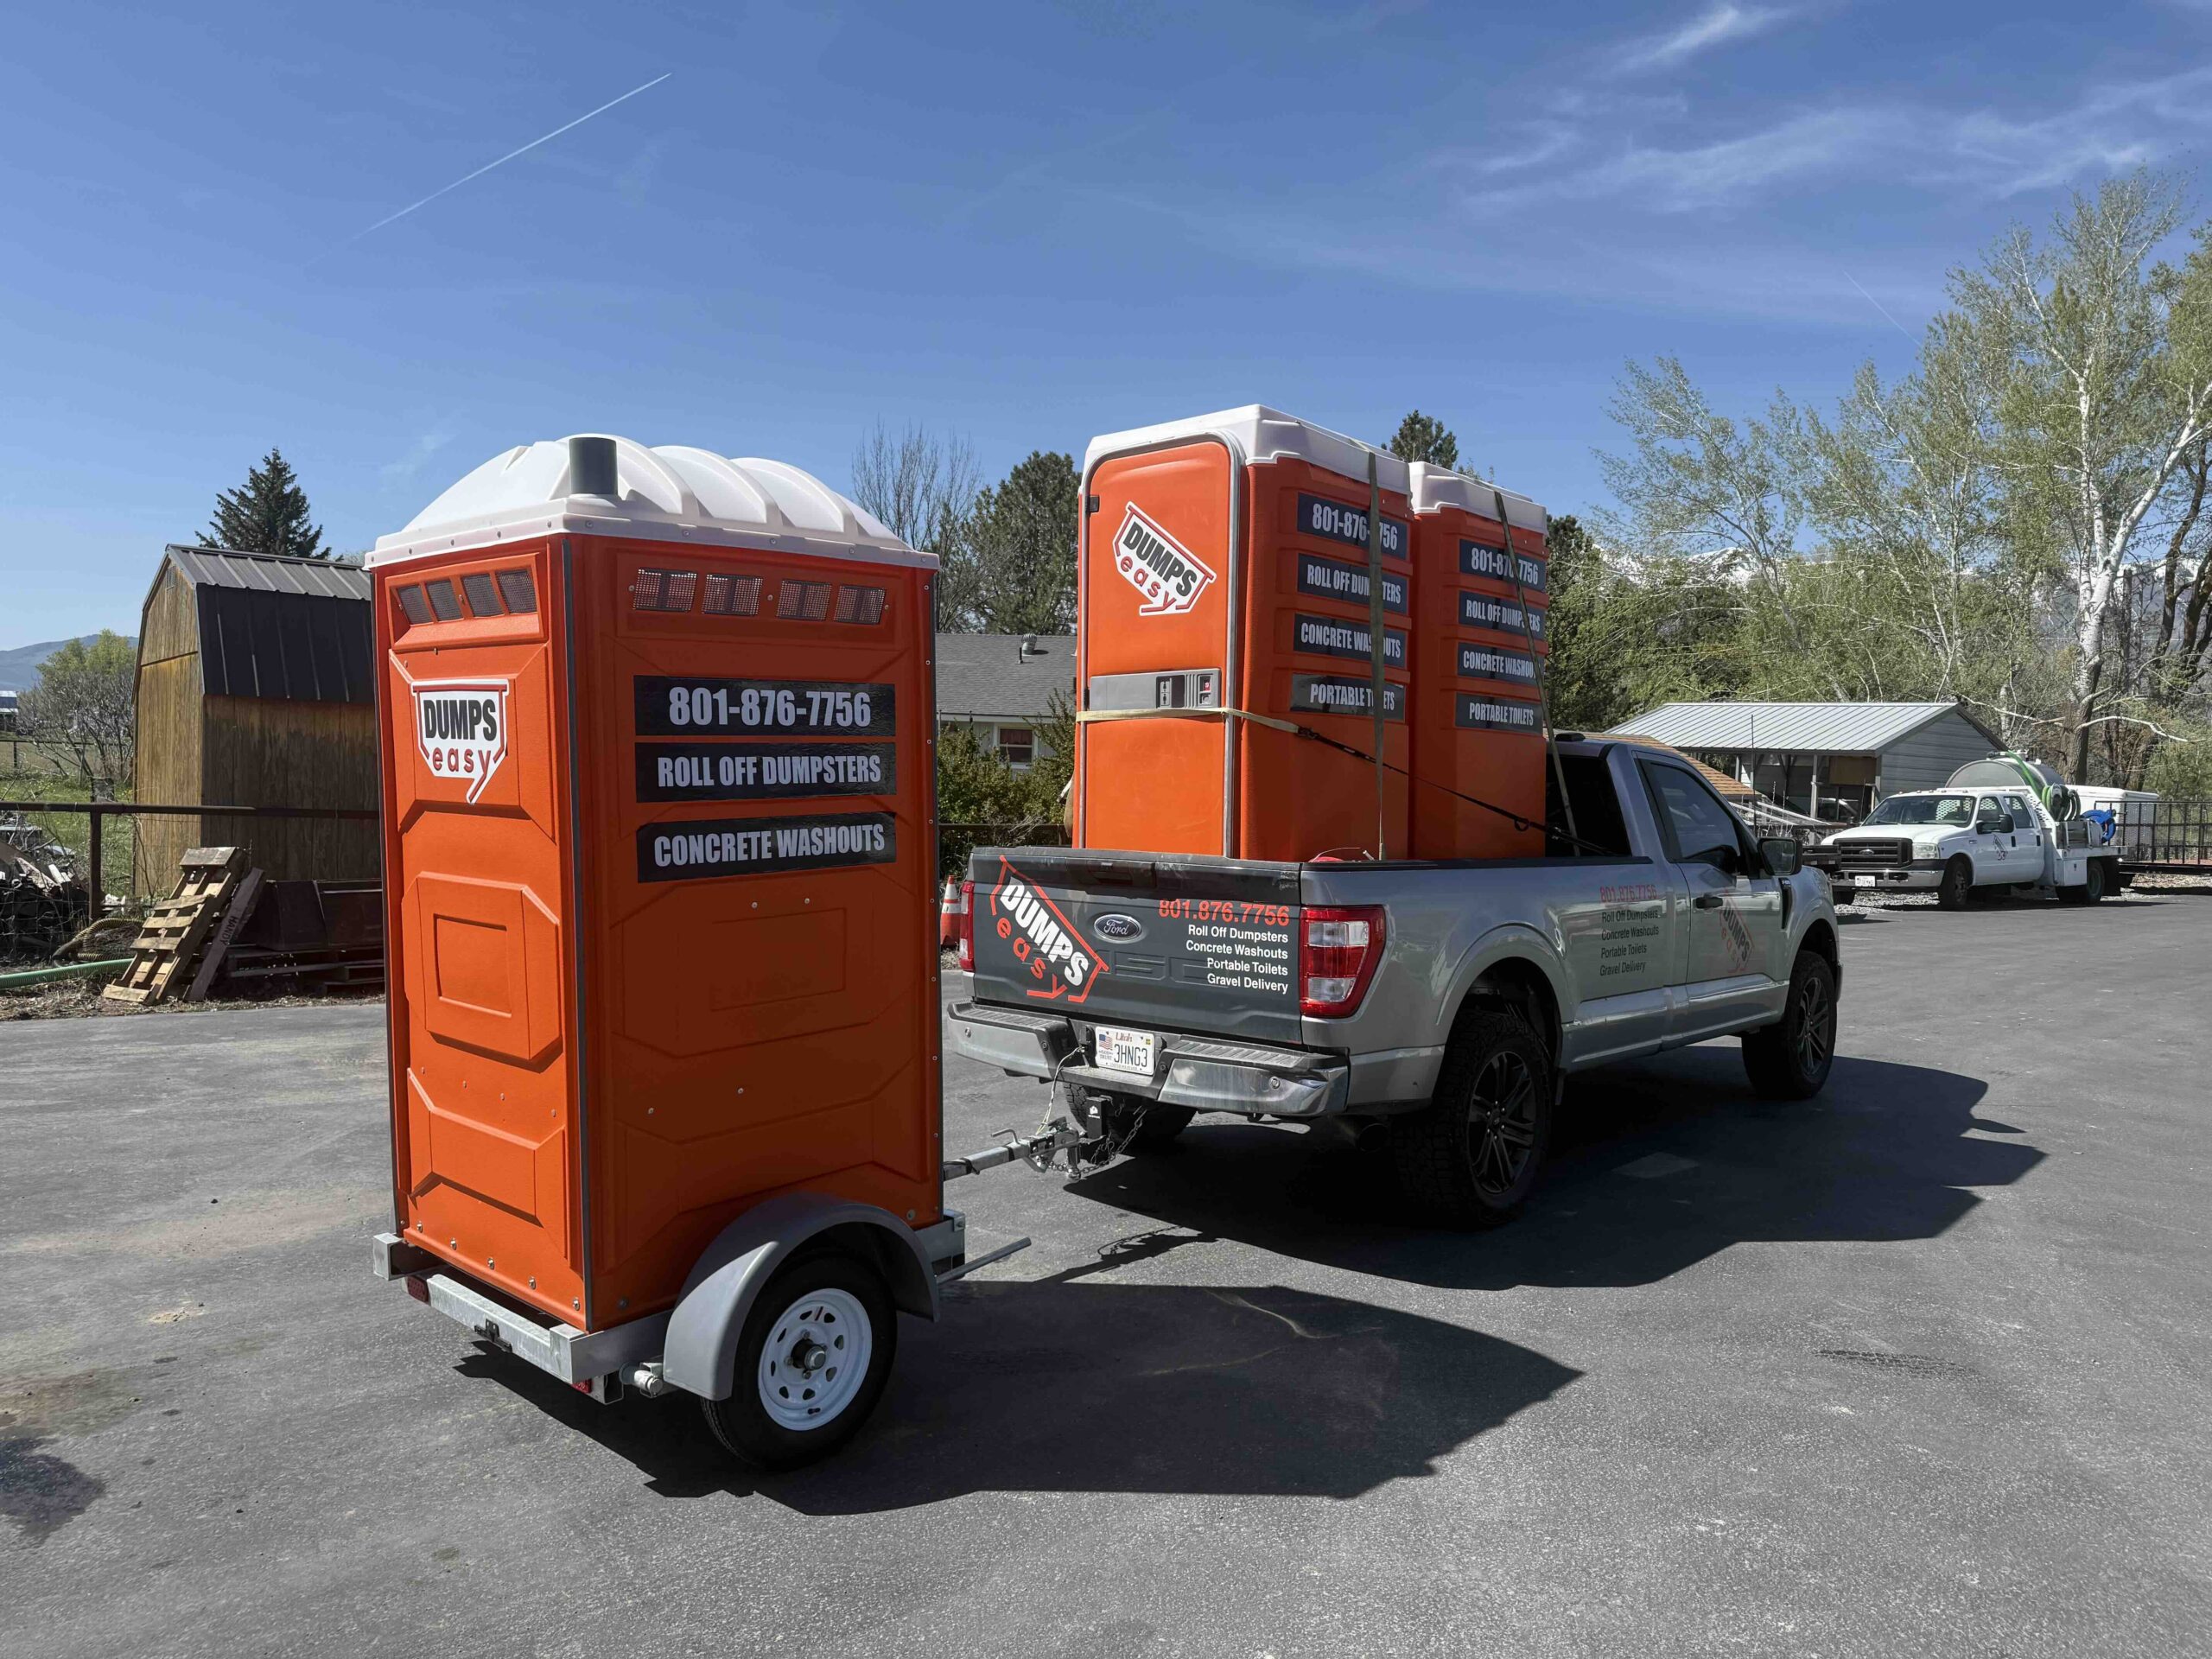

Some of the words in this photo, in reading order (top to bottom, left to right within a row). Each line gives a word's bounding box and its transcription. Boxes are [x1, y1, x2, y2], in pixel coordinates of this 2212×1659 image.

[1122, 521, 1198, 597] DUMPS
[1120, 556, 1177, 613] easy
[1306, 563, 1332, 588] ROLL
[1333, 569, 1351, 592] OFF
[1465, 599, 1486, 620] ROLL
[1487, 603, 1501, 622] OFF
[1300, 622, 1352, 649] CONCRETE
[1463, 651, 1504, 673] CONCRETE
[669, 687, 871, 727] 801-876-7756
[1310, 683, 1365, 707] PORTABLE
[423, 698, 498, 741] DUMPS
[1469, 702, 1508, 723] PORTABLE
[1509, 706, 1534, 726] TOILETS
[432, 747, 492, 804] easy
[658, 756, 715, 787] ROLL
[719, 756, 757, 785] OFF
[762, 755, 881, 785] DUMPSTERS
[654, 830, 772, 867] CONCRETE
[776, 823, 885, 858] WASHOUTS
[1599, 884, 1658, 903] 801.876.7756
[1159, 898, 1290, 927] 801.876.7756
[1602, 912, 1615, 923] Roll
[1616, 910, 1625, 922] Off
[1626, 908, 1658, 922] Dumpsters
[1000, 876, 1089, 987] DUMPS
[1103, 918, 1129, 936] Ford
[1188, 924, 1208, 938] Roll
[1211, 926, 1227, 938] Off
[1230, 927, 1289, 944] Dumpsters
[1601, 928, 1630, 941] Concrete
[1630, 925, 1660, 938] Washouts
[1722, 901, 1751, 962] DUMPS
[996, 917, 1068, 1000] easy
[1185, 940, 1234, 956] Concrete
[1235, 943, 1289, 960] Washouts
[1600, 945, 1627, 959] Portable
[1628, 943, 1648, 956] Toilets
[1207, 958, 1250, 974] Portable
[1252, 962, 1289, 976] Toilets
[1599, 963, 1621, 976] Gravel
[1621, 960, 1646, 974] Delivery
[1207, 974, 1242, 988] Gravel
[1243, 977, 1289, 995] Delivery
[1114, 1043, 1148, 1068] 3HNG3
